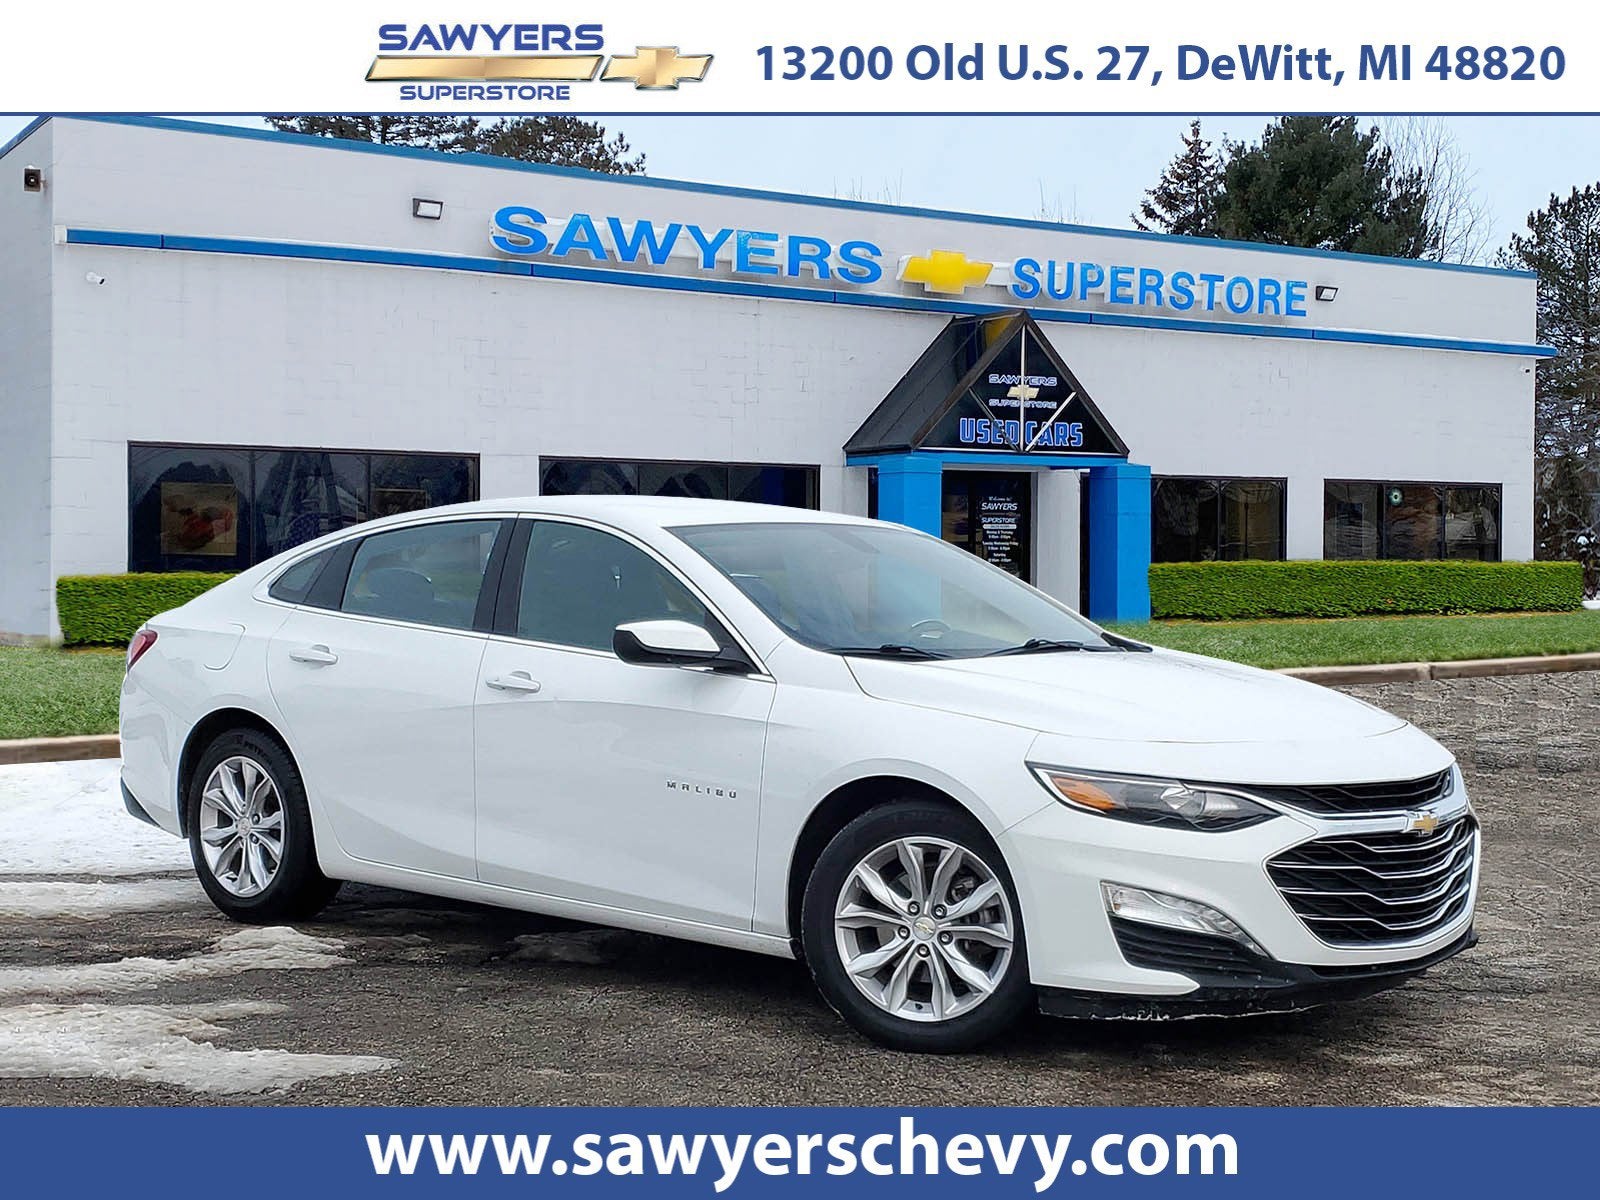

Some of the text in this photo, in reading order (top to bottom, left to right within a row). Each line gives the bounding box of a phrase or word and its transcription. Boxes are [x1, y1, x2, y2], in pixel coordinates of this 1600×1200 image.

[489, 205, 883, 286] SAWYERS
[1010, 257, 1308, 318] SUPERSTORE
[988, 373, 1057, 387] SAWYERS
[959, 417, 1083, 447] USED CARS
[981, 502, 1018, 511] SAWYERS
[666, 780, 737, 799] MALIBU
